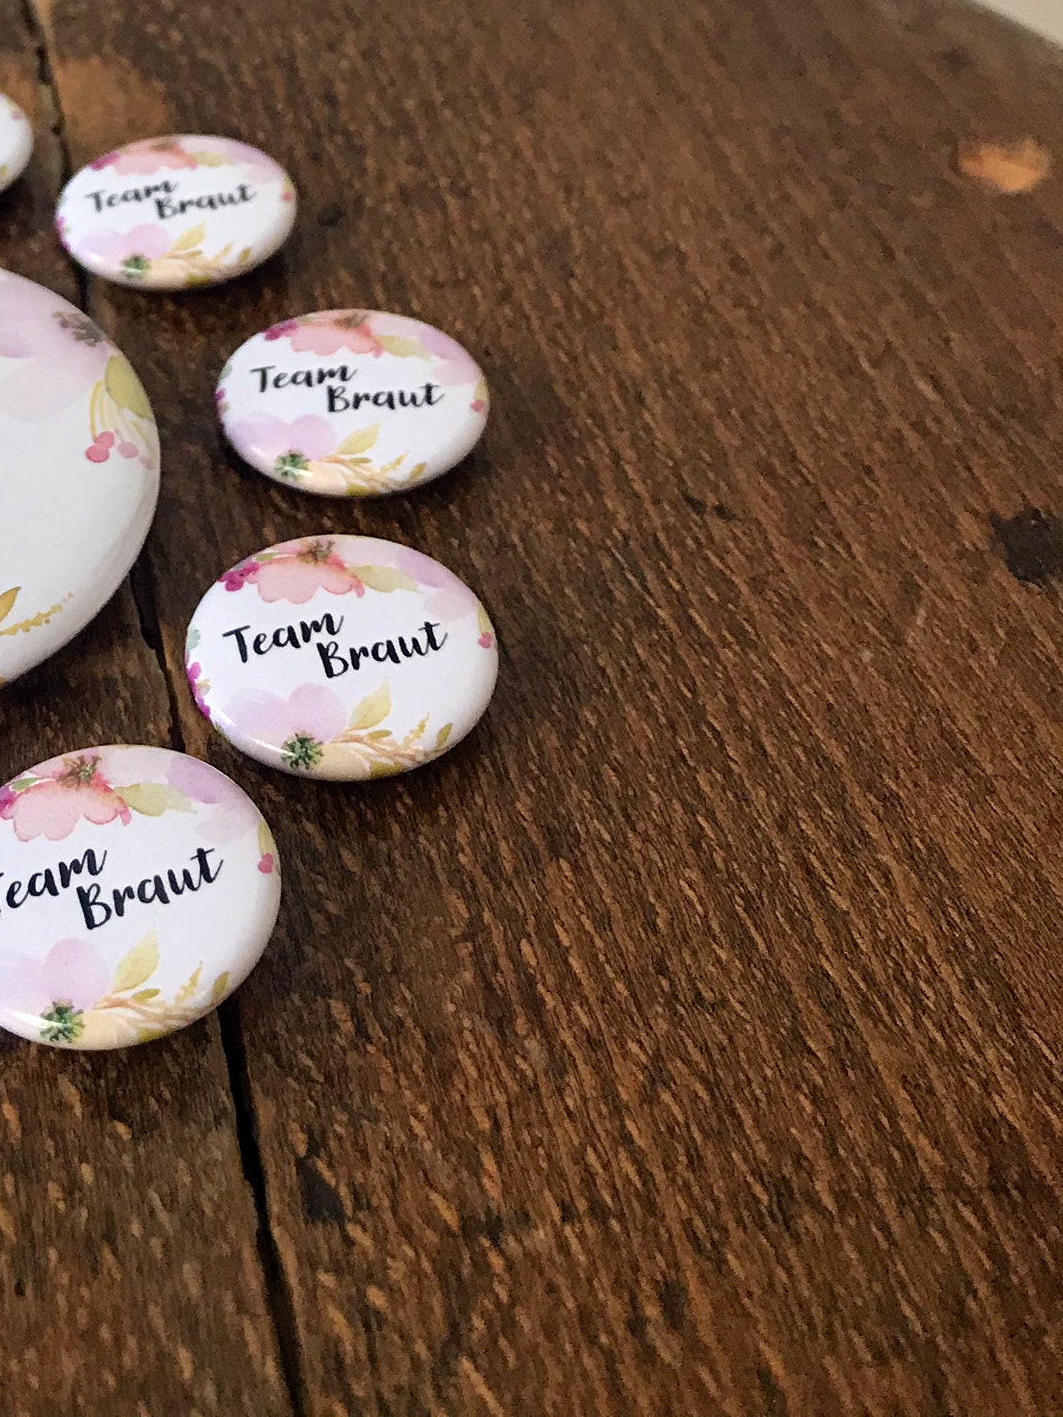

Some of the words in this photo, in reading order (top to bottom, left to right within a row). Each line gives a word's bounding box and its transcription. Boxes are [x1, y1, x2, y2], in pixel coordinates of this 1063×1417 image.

[84, 178, 178, 213] Team
[155, 182, 257, 221] Braut
[250, 359, 357, 394] Team
[326, 383, 448, 413] Braut
[223, 612, 344, 663] Team
[317, 620, 448, 679] Braut
[76, 847, 226, 930] Braut
